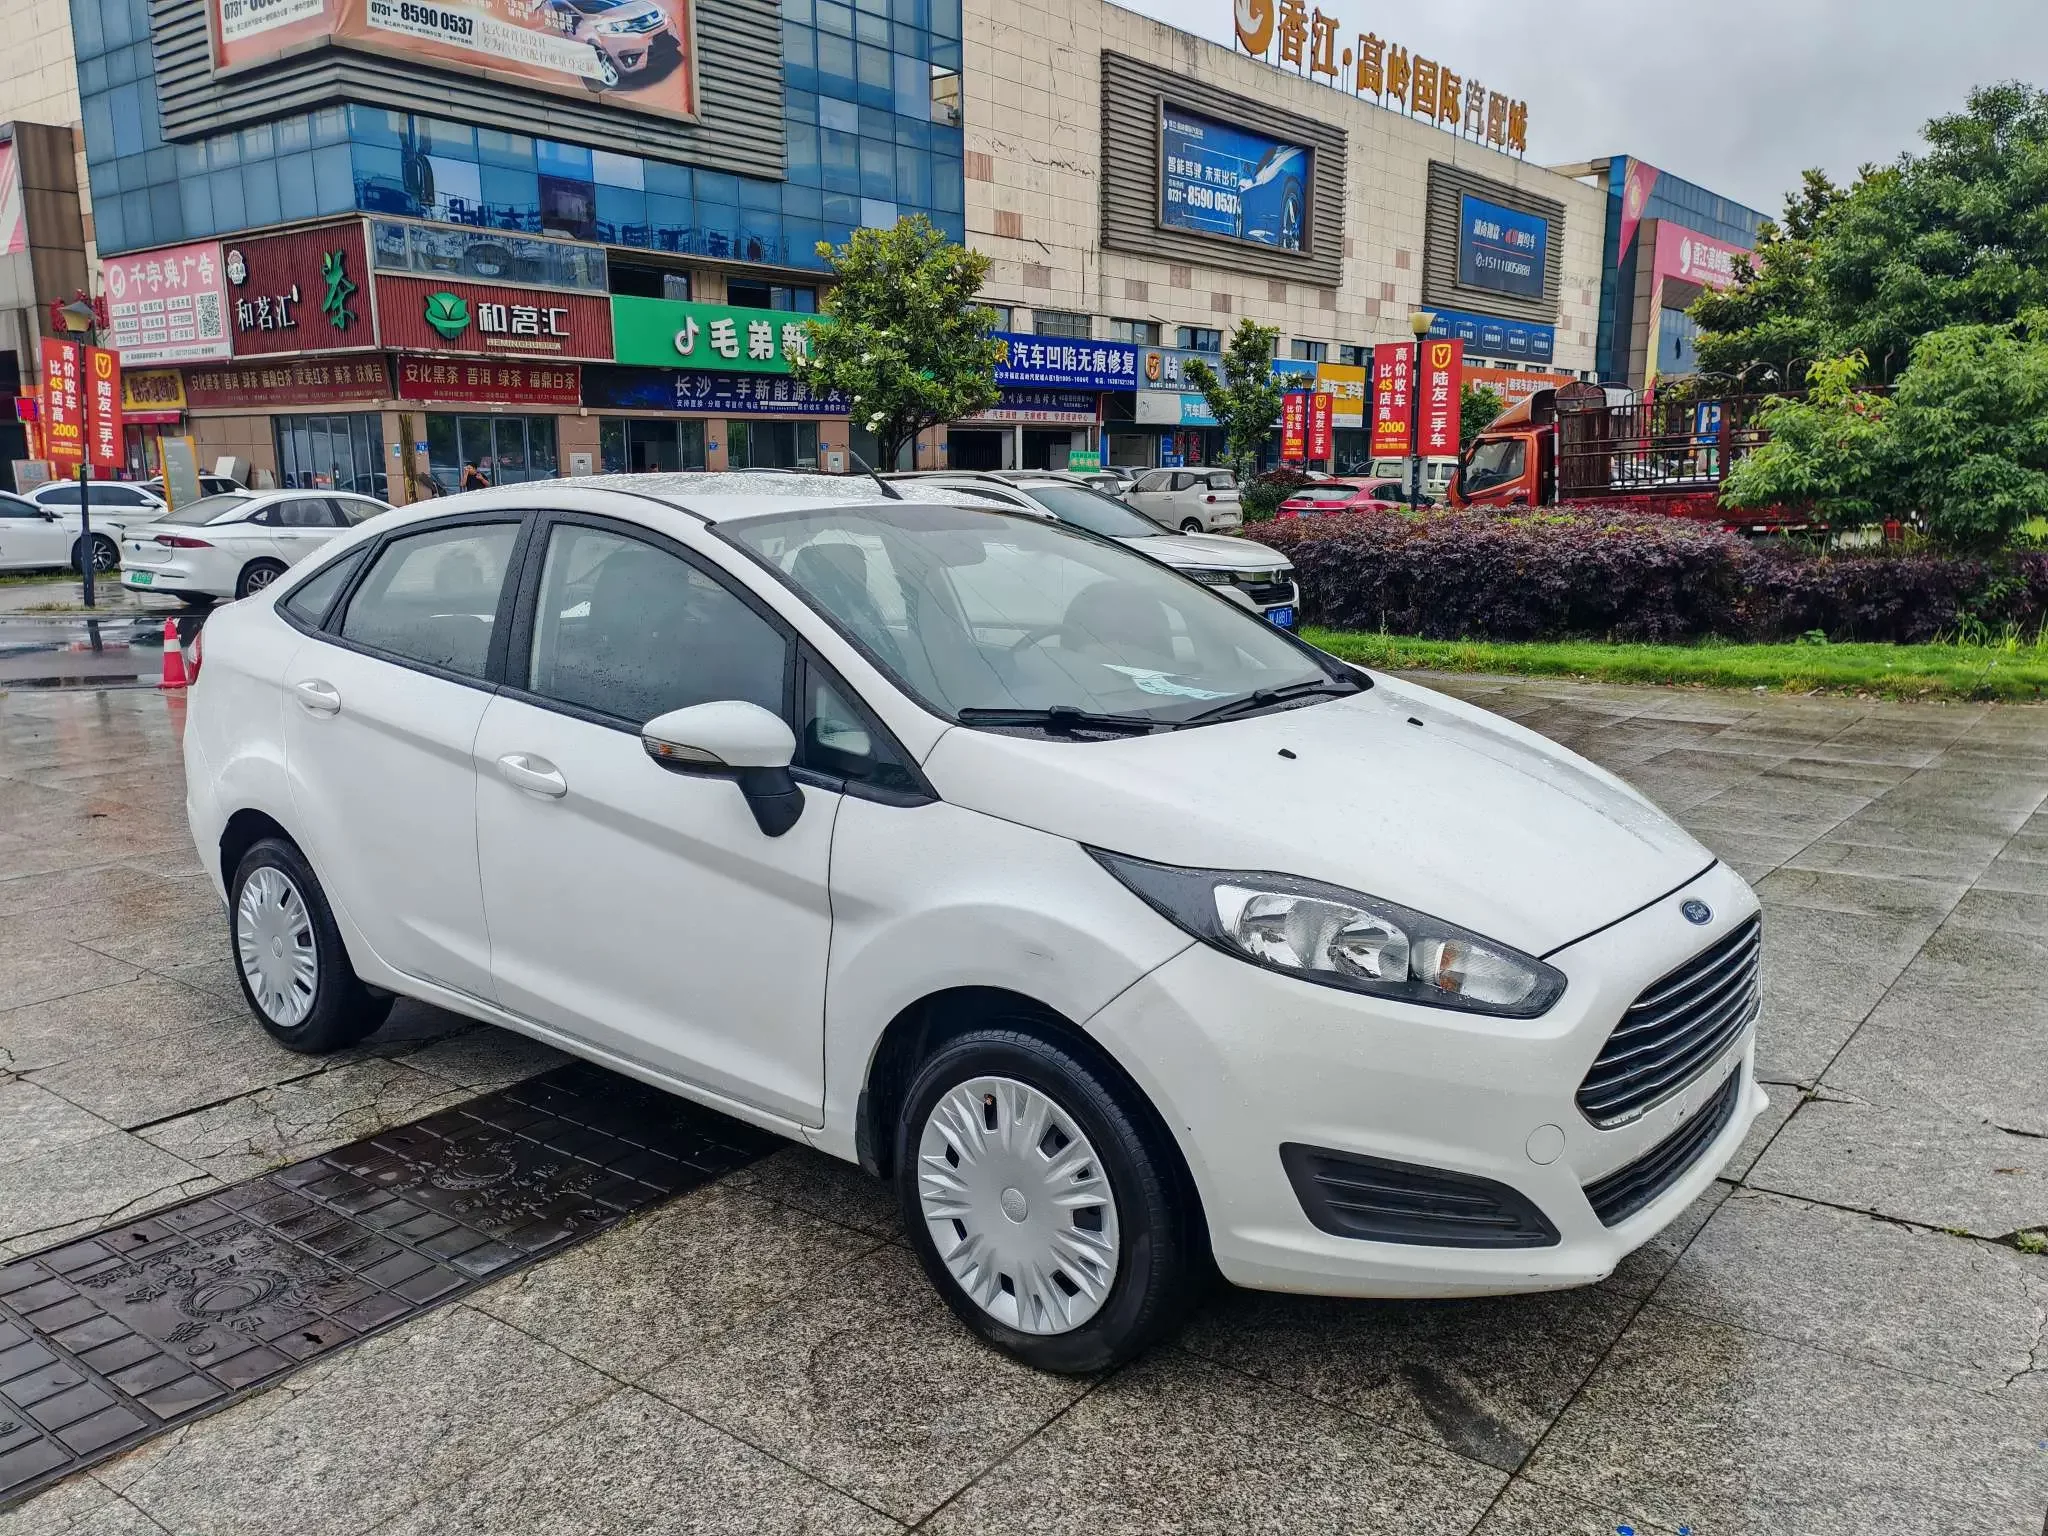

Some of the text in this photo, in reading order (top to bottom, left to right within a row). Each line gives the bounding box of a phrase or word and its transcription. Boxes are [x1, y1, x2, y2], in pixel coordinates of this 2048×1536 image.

[1167, 155, 1239, 188] 智能驾驶 未来出行
[478, 302, 571, 337] 和茗汇
[1013, 341, 1135, 375] 汽车凹陷无痕修复
[62, 345, 77, 411] 高价收车
[405, 363, 576, 390] 安化黑茶 普洱 绿茶 福鼎白茶
[1394, 347, 1408, 408] 高价收车
[97, 380, 114, 459] 陆友二手车
[1430, 371, 1449, 448] 陆友二手车
[1700, 405, 1722, 433] P
[52, 423, 79, 438] 2000
[1378, 421, 1406, 433] 2000
